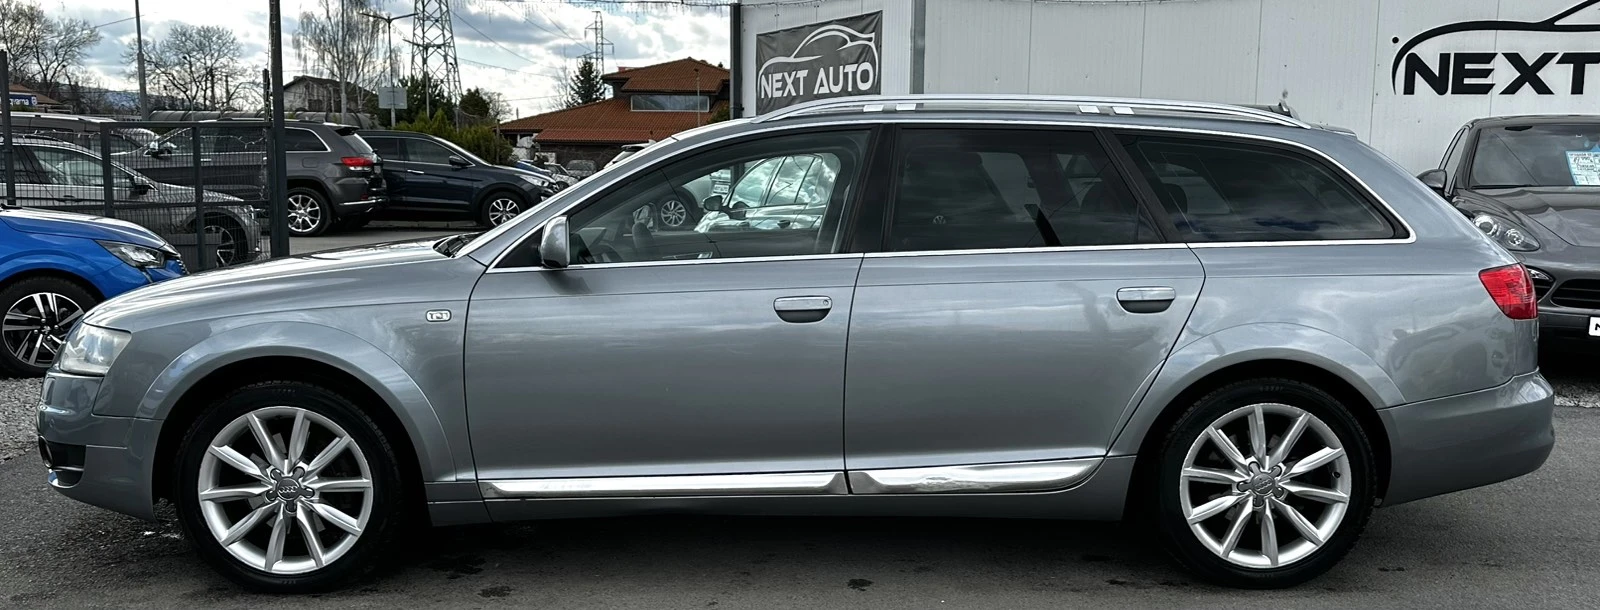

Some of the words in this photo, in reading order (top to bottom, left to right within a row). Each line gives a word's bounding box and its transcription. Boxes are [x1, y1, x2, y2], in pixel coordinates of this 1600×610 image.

[760, 69, 809, 99] NEXT
[813, 61, 874, 95] AUTO
[1403, 52, 1600, 95] NEXT
